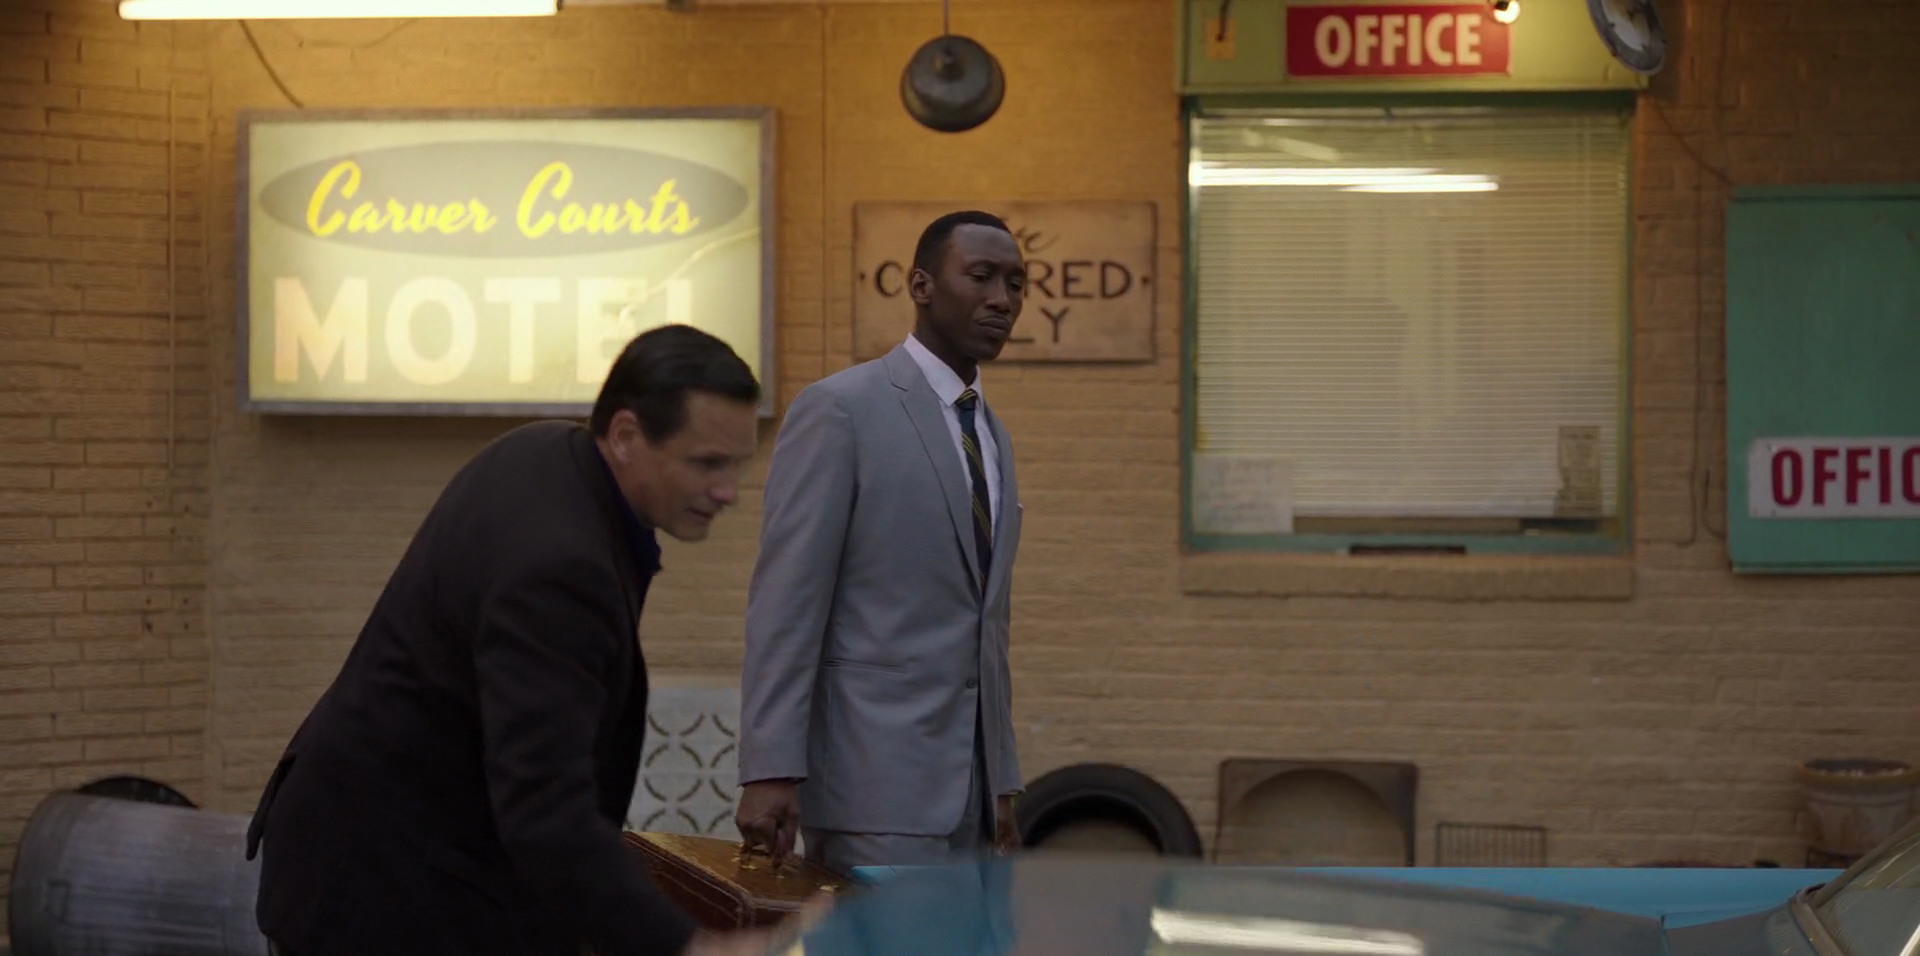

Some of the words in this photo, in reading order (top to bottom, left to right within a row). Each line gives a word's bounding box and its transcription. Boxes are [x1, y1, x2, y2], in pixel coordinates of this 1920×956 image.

[1314, 13, 1482, 68] OFFICE
[306, 161, 497, 237] Carver
[517, 161, 699, 239] Courts
[874, 259, 1132, 300] CRED
[1771, 446, 1920, 508] OFFIC
